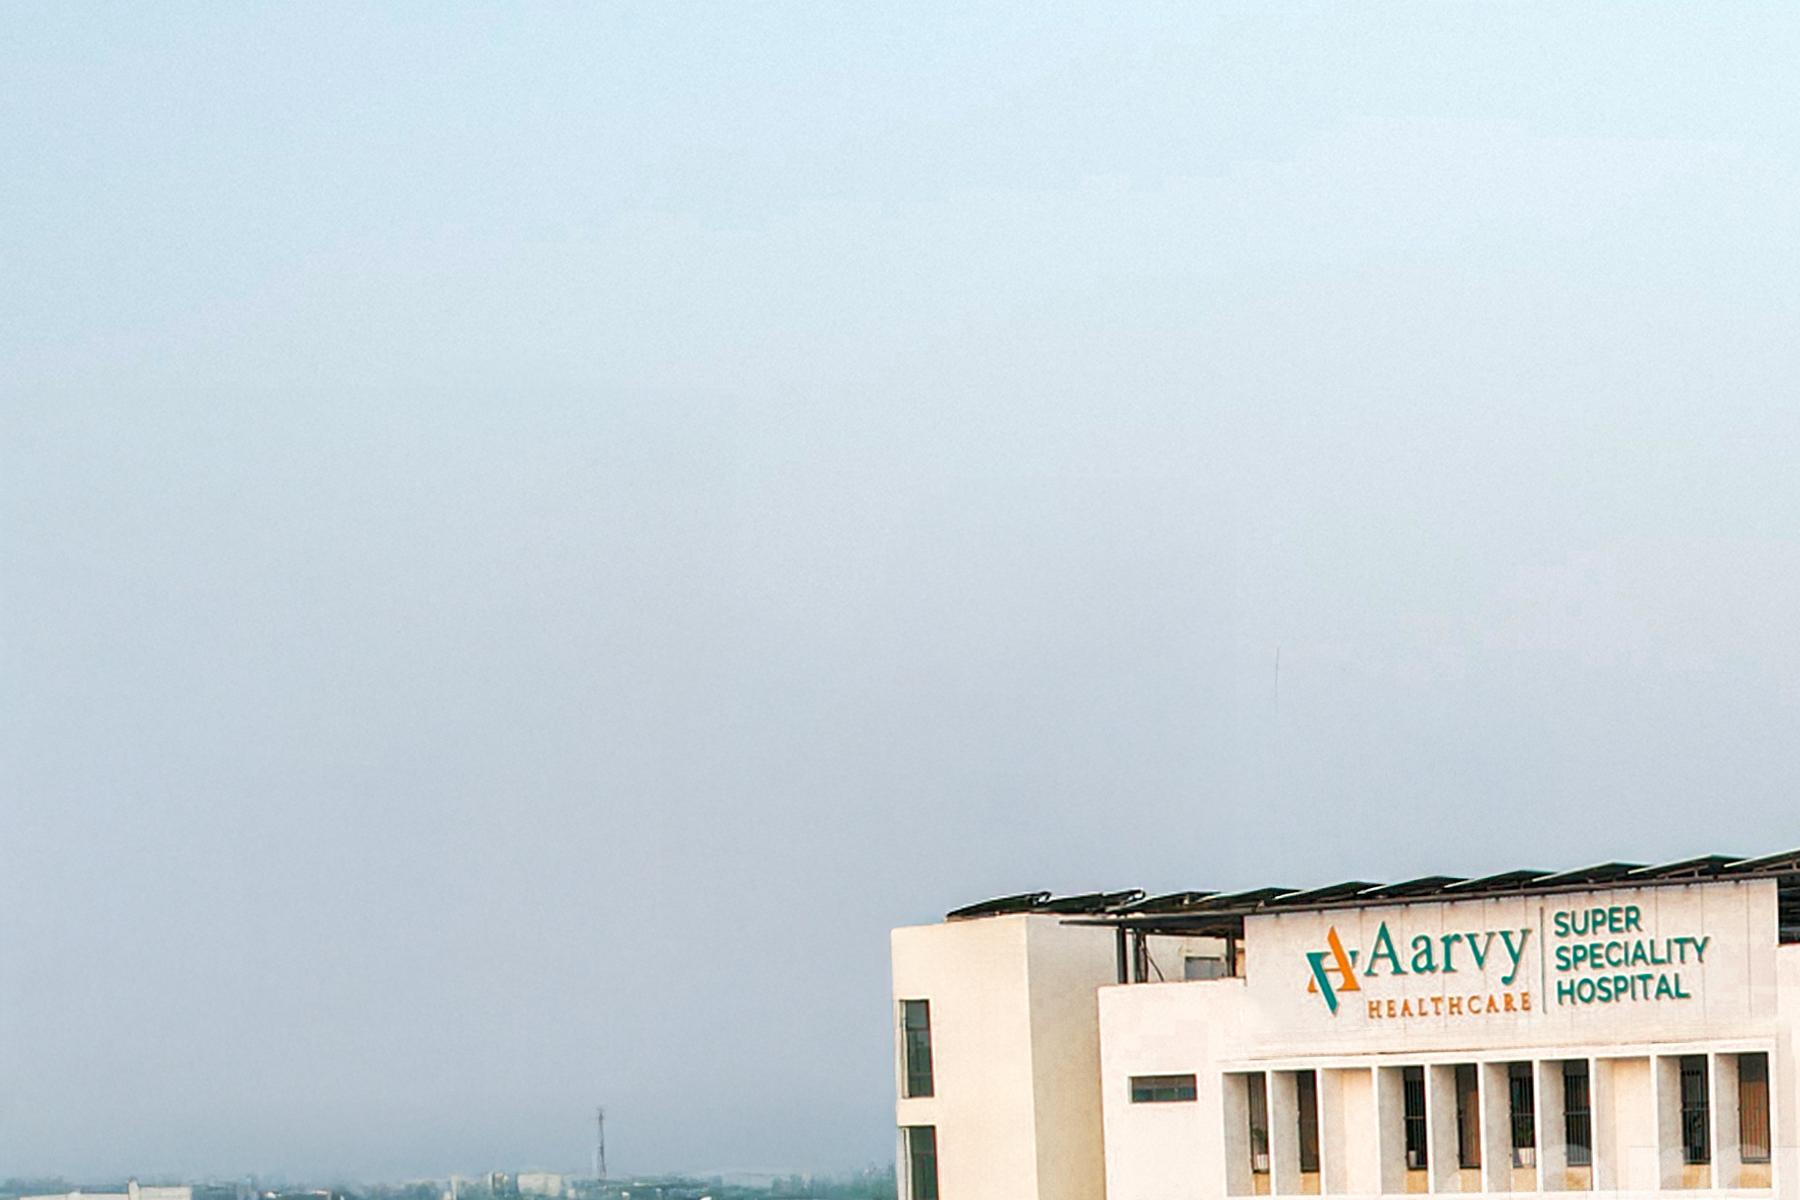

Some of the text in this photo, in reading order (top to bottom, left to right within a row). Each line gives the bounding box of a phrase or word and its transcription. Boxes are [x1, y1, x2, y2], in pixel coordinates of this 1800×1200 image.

[1554, 905, 1642, 938] SUPER
[1364, 920, 1533, 986] Aarvy
[1555, 936, 1710, 971] SPECIALITY
[1367, 991, 1532, 1019] HEALTHCARE
[1556, 973, 1692, 1005] HOSPITAL
